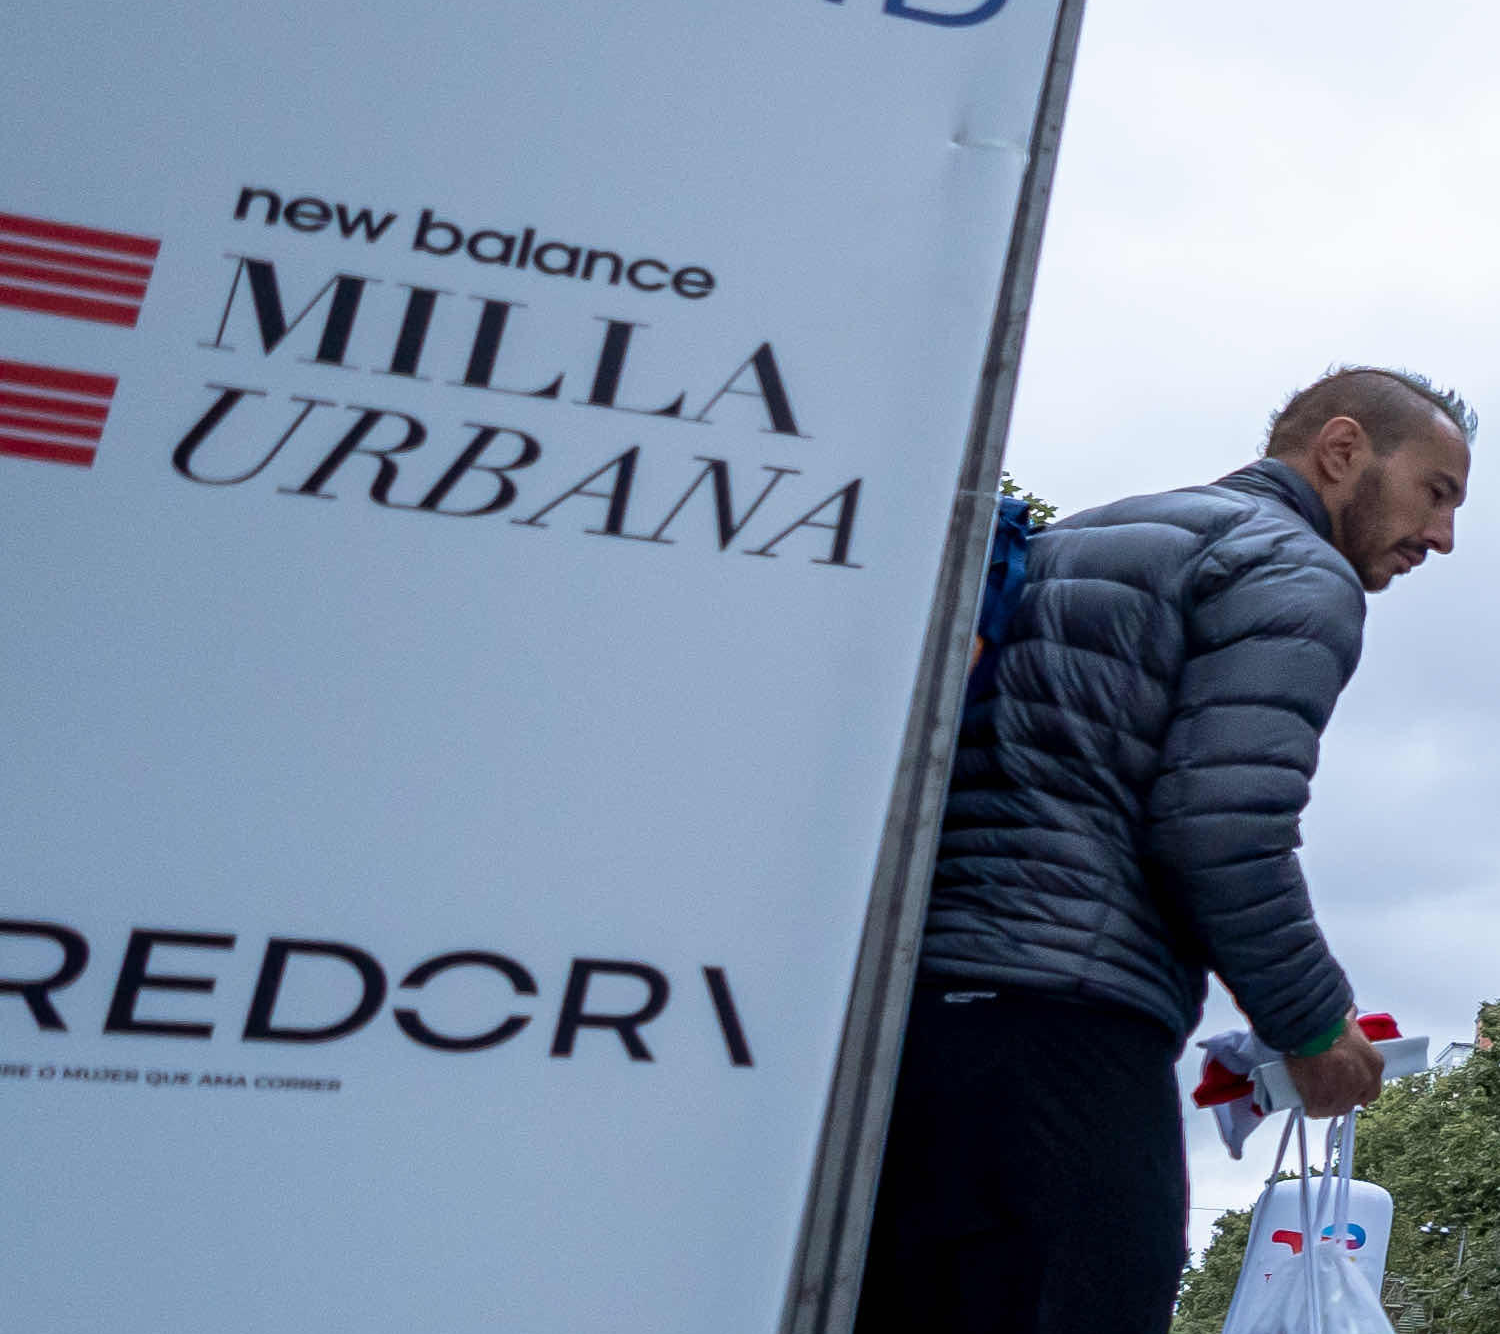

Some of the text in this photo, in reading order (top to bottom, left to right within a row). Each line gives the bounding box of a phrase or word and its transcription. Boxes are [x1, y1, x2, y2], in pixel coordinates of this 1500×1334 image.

[233, 184, 717, 301] new balance
[197, 253, 813, 439] MILLA
[171, 382, 864, 569] URBANA
[62, 1067, 139, 1084] MUJER
[145, 1070, 192, 1089] QUE
[198, 1073, 248, 1091] AMA
[254, 1074, 343, 1093] CORRER
